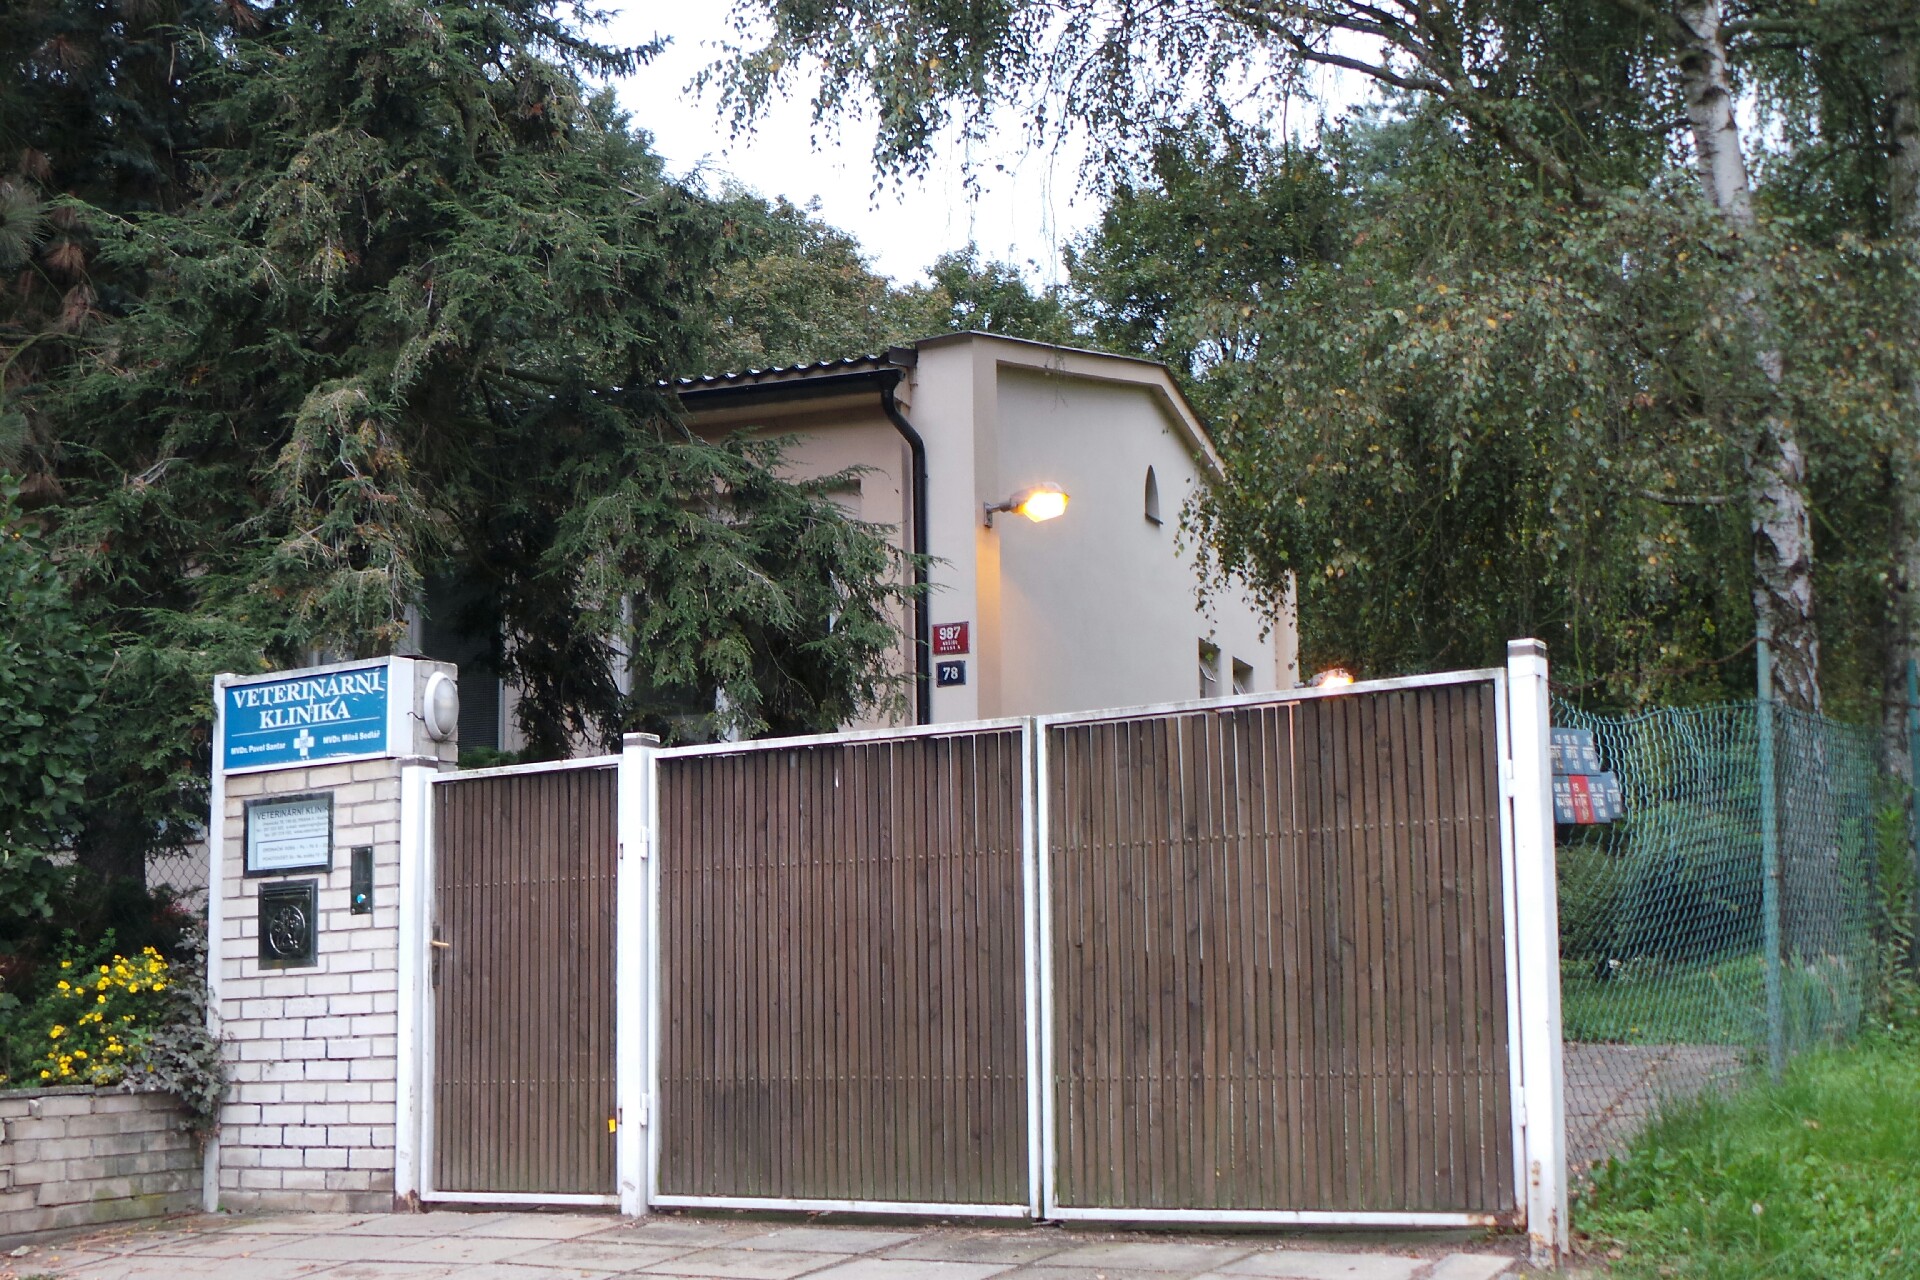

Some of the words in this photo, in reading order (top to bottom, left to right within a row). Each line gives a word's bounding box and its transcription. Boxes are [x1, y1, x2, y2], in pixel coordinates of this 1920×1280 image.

[940, 626, 961, 640] 987
[943, 667, 958, 680] 78
[233, 669, 384, 708] VETERINÁRNÍ
[259, 700, 351, 729] KLINIKA
